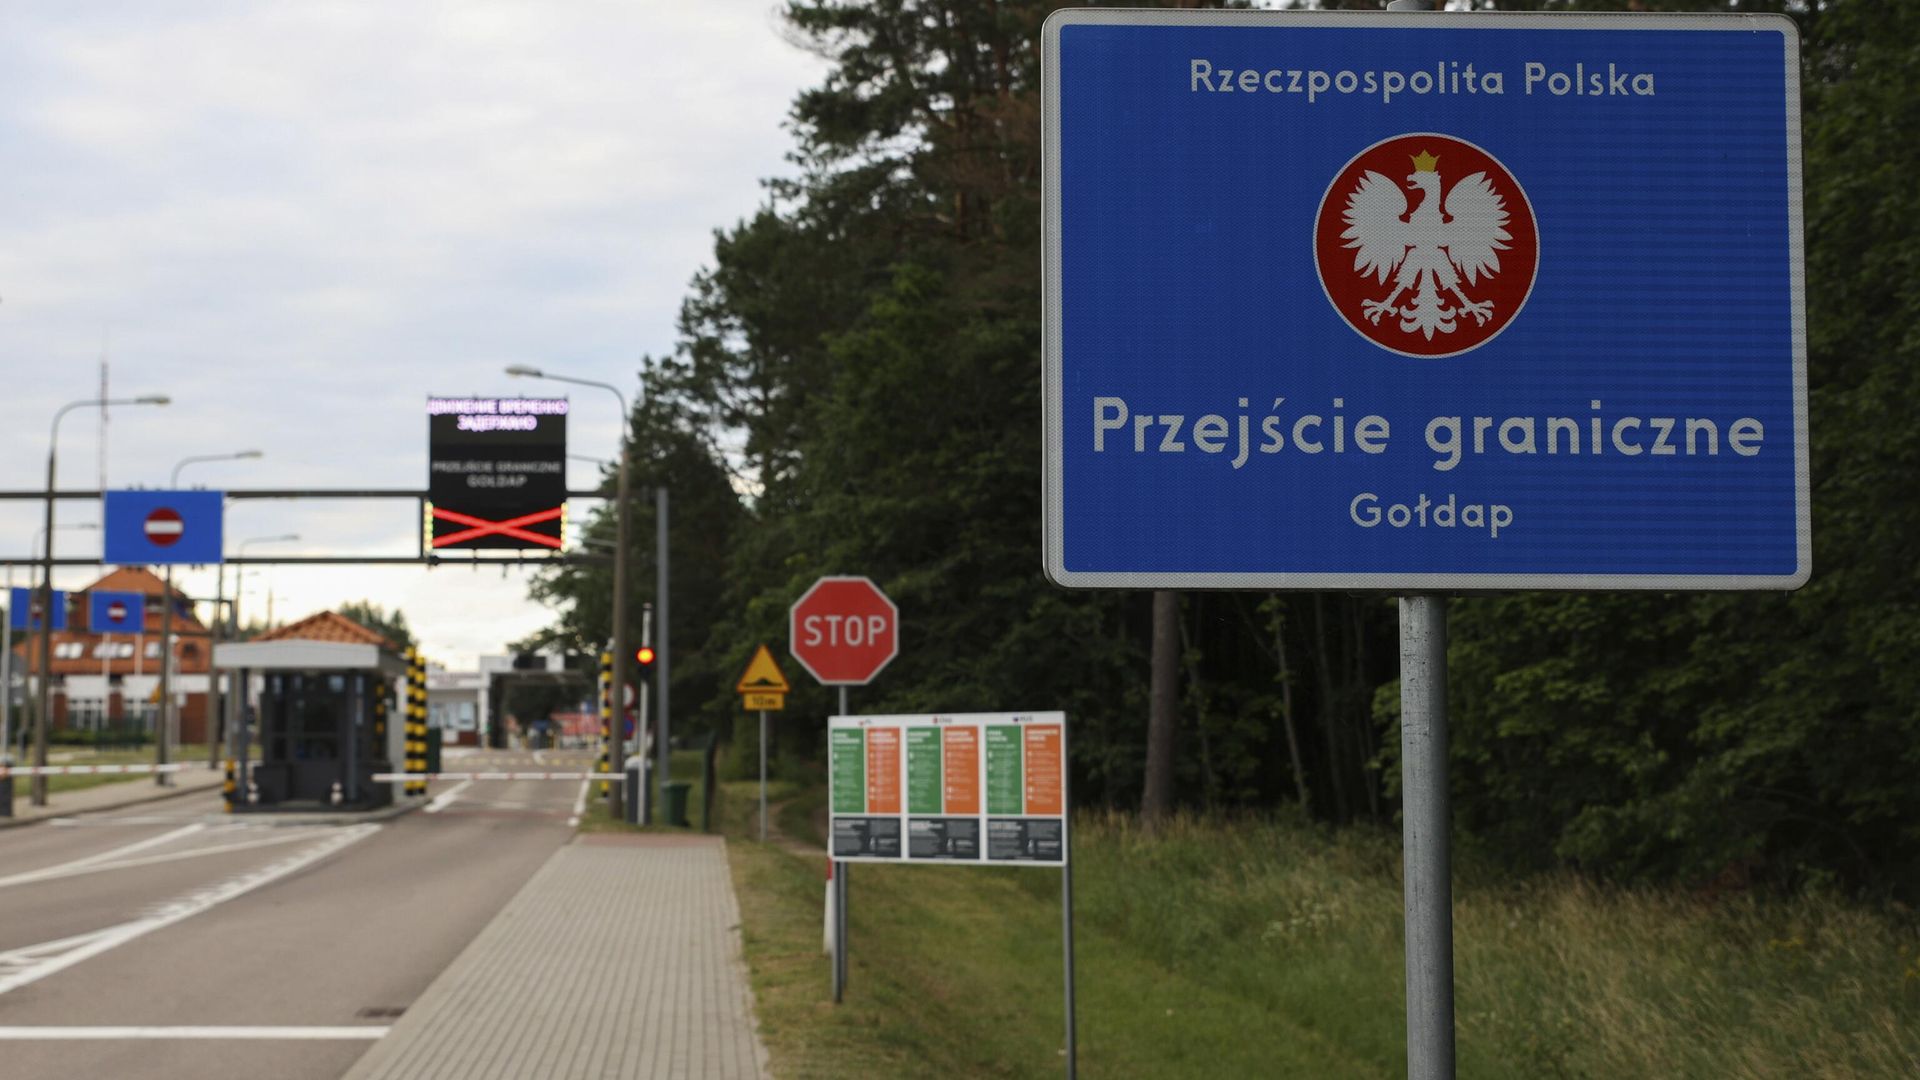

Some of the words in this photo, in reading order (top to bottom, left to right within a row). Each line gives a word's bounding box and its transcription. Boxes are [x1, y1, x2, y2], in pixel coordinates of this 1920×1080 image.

[1191, 59, 1504, 103] Rzeczpospolita
[1525, 62, 1655, 96] Polska
[1093, 396, 1390, 469] Przejście
[1424, 399, 1764, 471] graniczne
[1350, 493, 1513, 538] Gołdap
[804, 615, 887, 647] STOP
